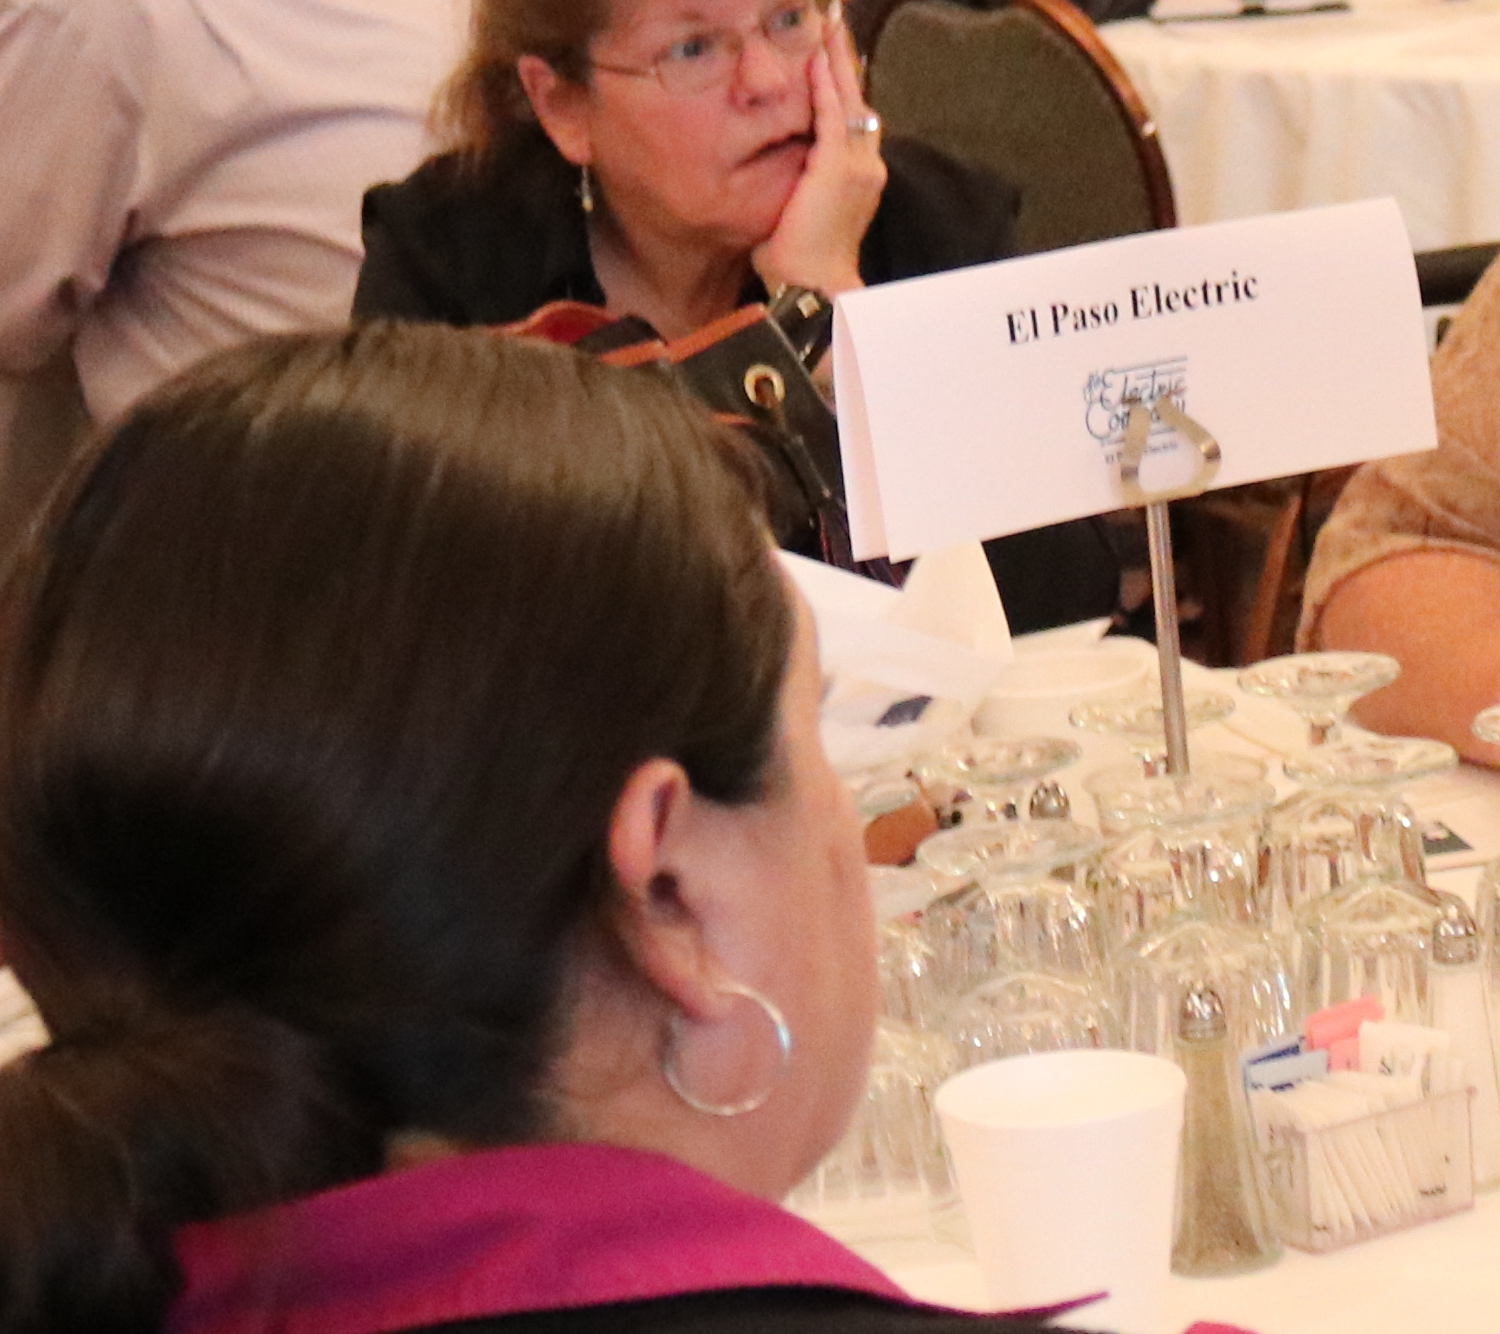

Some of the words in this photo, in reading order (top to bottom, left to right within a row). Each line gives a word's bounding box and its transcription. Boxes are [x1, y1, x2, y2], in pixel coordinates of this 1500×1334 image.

[1006, 308, 1040, 345] El
[1050, 301, 1119, 336] Paso
[1130, 271, 1259, 320] Electric
